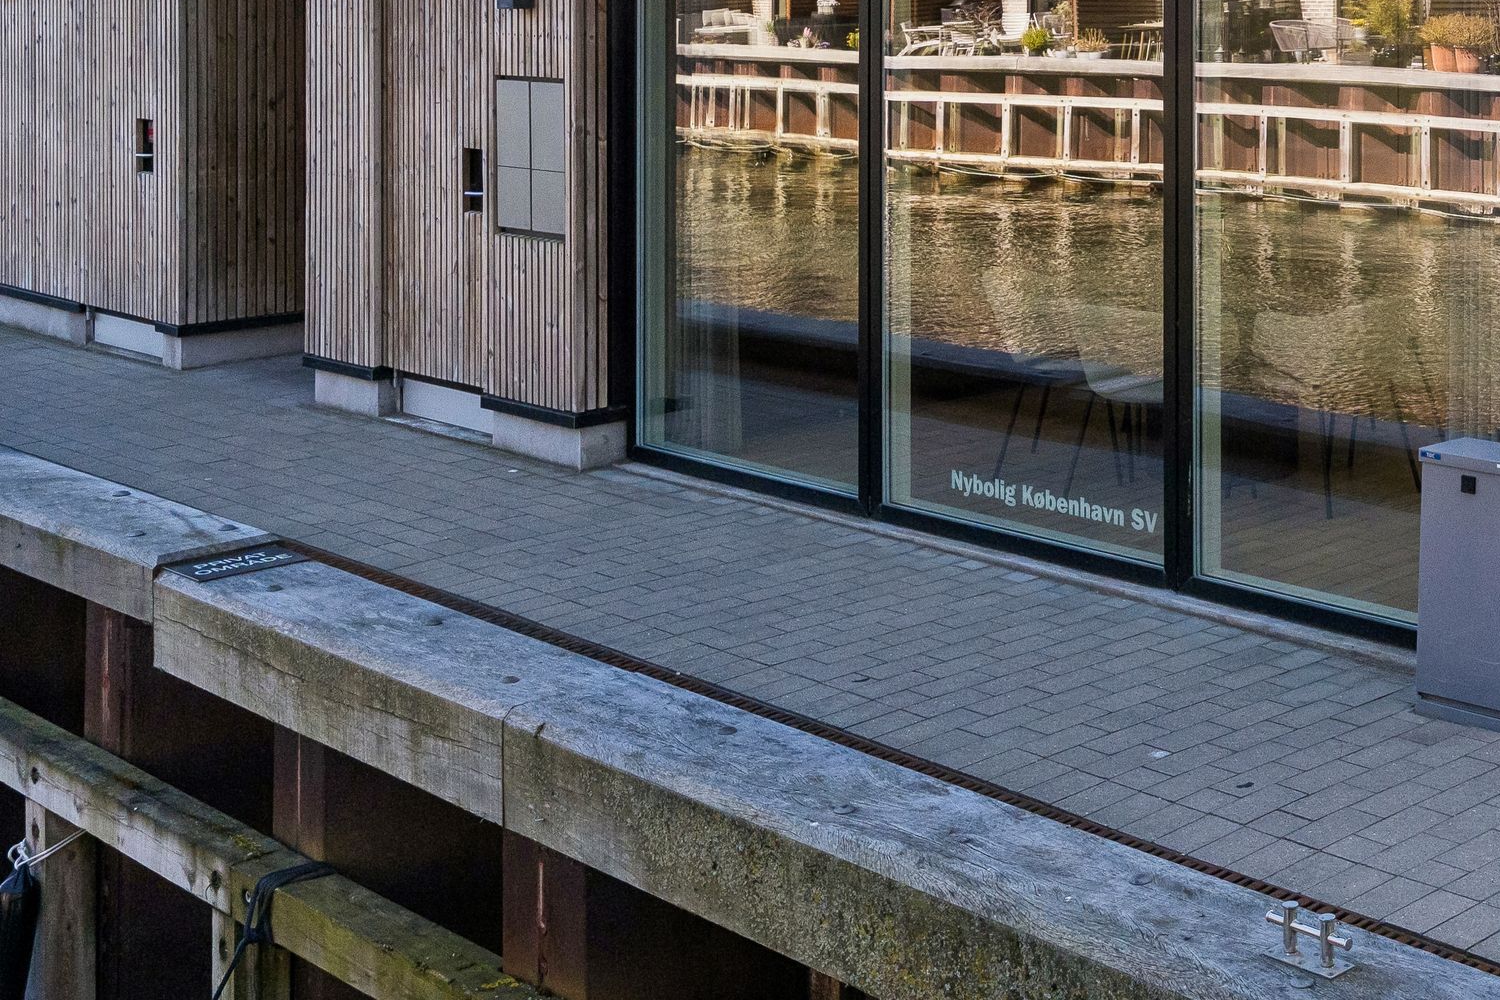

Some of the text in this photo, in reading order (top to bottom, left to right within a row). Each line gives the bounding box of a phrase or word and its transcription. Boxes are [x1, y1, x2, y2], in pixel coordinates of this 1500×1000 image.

[951, 469, 1159, 534] Nybolig København SV
[193, 552, 267, 569] PRIVAT
